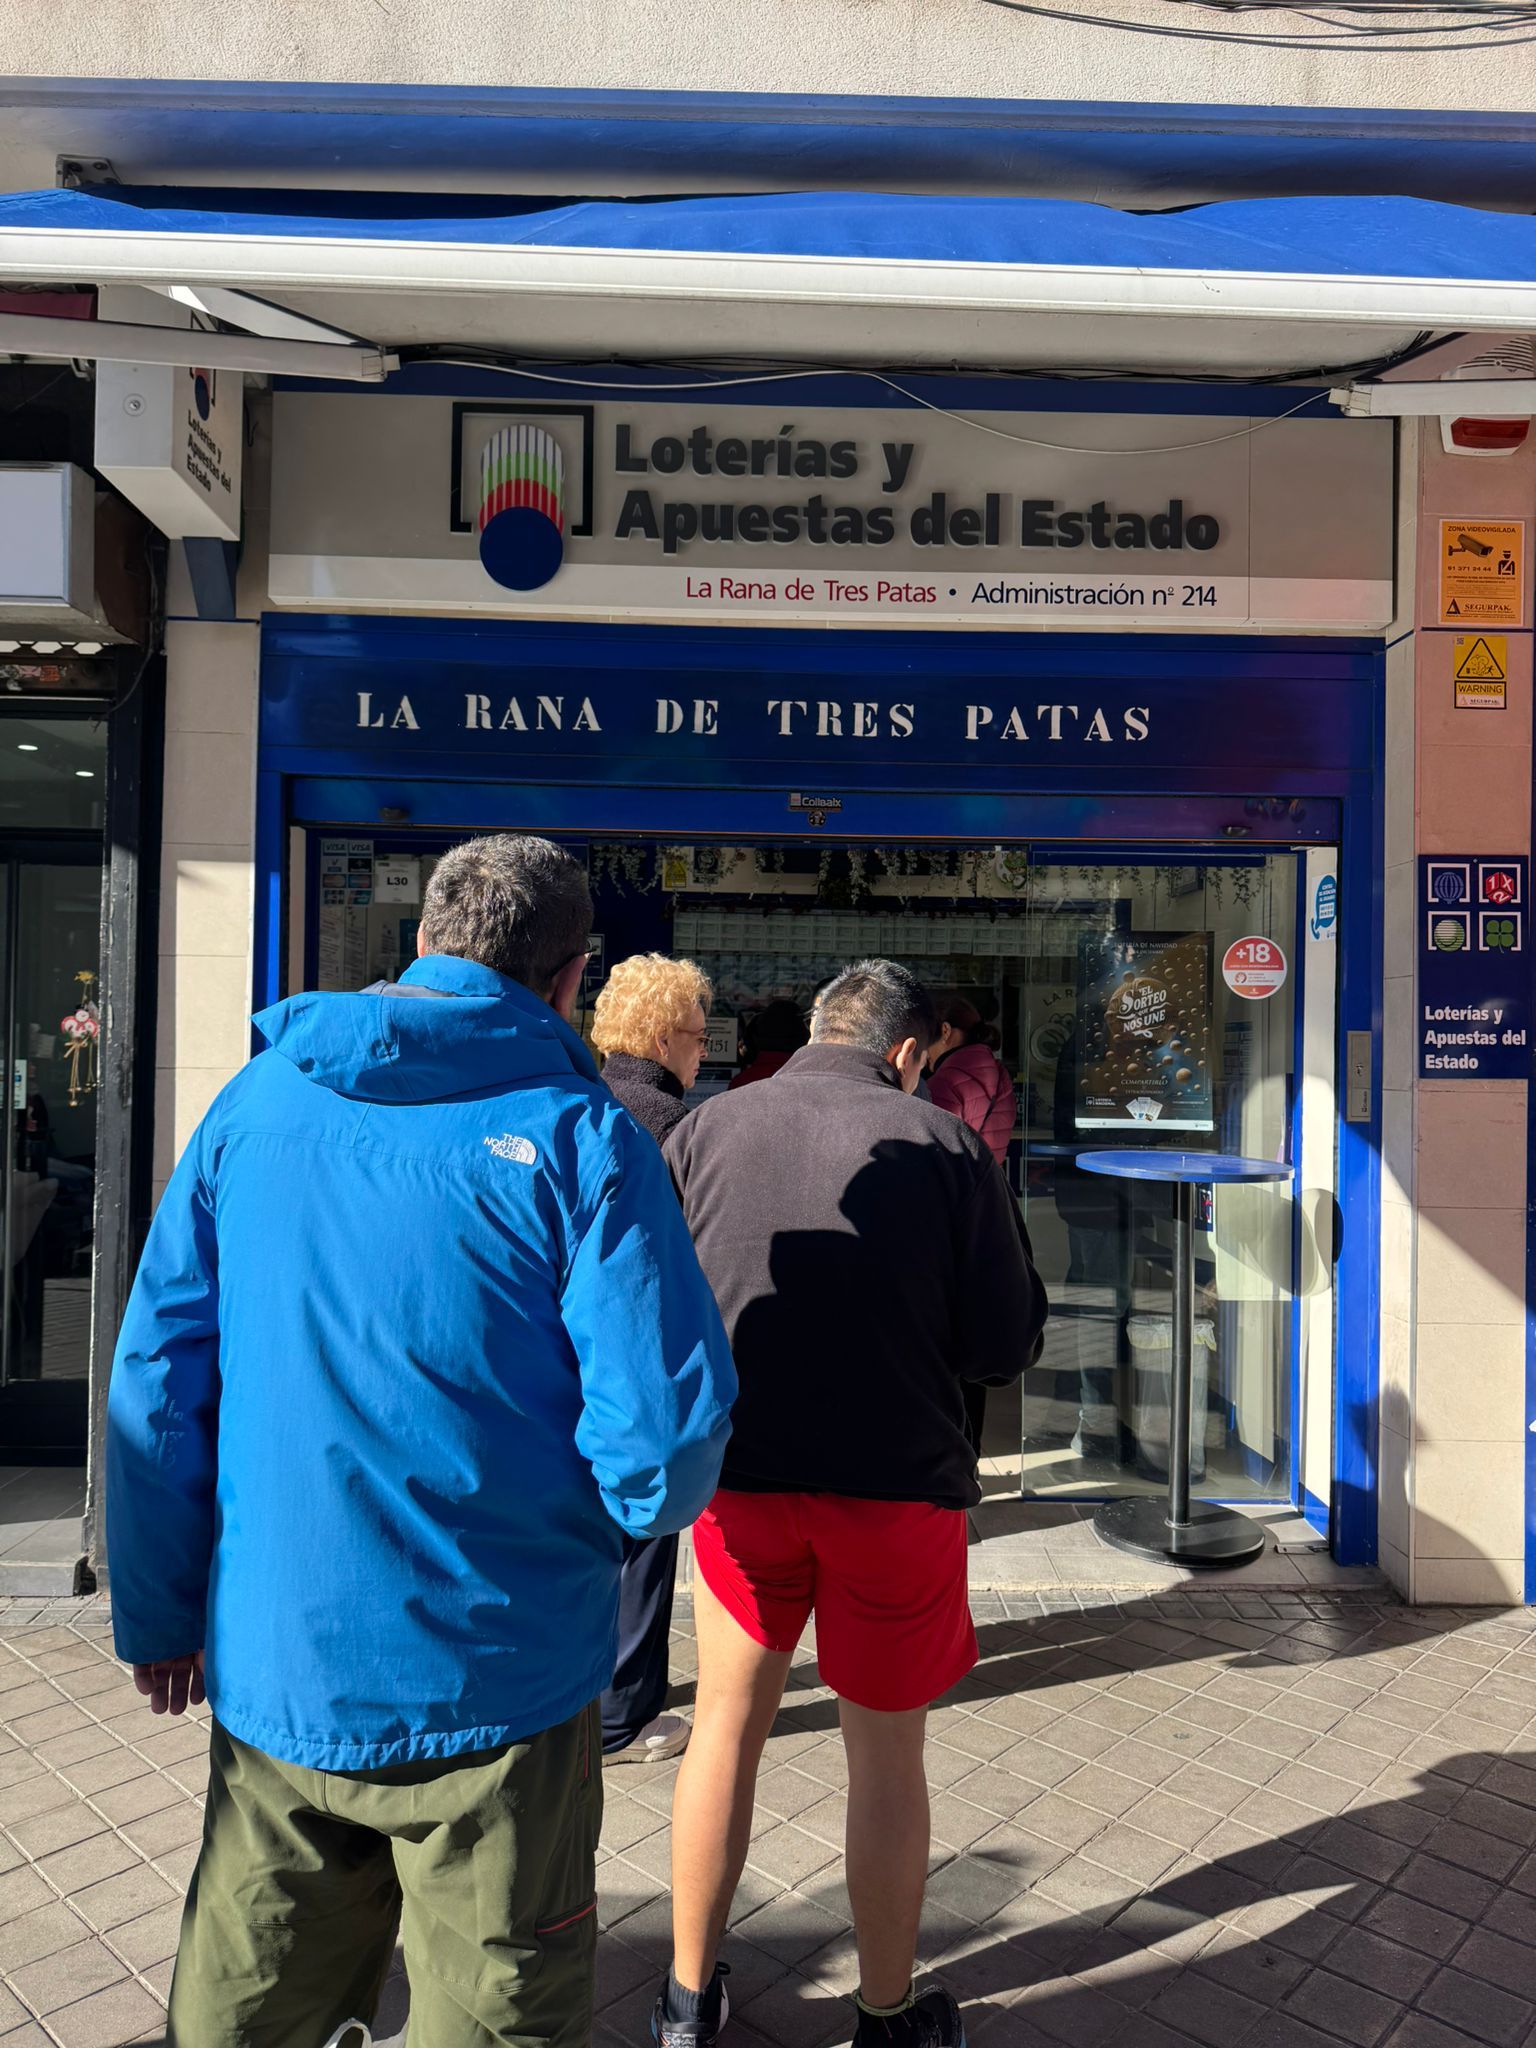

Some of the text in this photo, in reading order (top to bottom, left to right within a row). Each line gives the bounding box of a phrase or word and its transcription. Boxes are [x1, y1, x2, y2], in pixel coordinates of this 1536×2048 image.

[188, 409, 222, 465] Loterías y
[188, 433, 231, 493] Apuestas del
[615, 423, 915, 493] Loterías y
[188, 454, 211, 492] Estado
[615, 489, 1220, 554] Apuestas del Estado
[686, 576, 713, 601] La
[719, 577, 777, 602] Rana
[784, 578, 815, 602] de
[824, 579, 870, 603] Tres
[876, 580, 937, 604] Patas
[971, 582, 1145, 607] Administración
[1181, 584, 1217, 607] 214
[1458, 684, 1503, 693] WARNING
[356, 692, 1151, 742] LA RANA DE TRES PATAS
[352, 843, 370, 851] VISA
[387, 877, 408, 886] L30
[1236, 943, 1271, 963] +18
[1139, 985, 1153, 996] EL
[1121, 988, 1167, 1014] SORTEO
[1123, 1009, 1166, 1033] NOS UNE
[1425, 1005, 1503, 1025] Loterías y
[1424, 1030, 1526, 1048] Apuestas del
[1425, 1054, 1479, 1070] Estado
[484, 1136, 521, 1152] NORTH
[503, 1133, 524, 1145] THE
[490, 1145, 518, 1160] FACE
